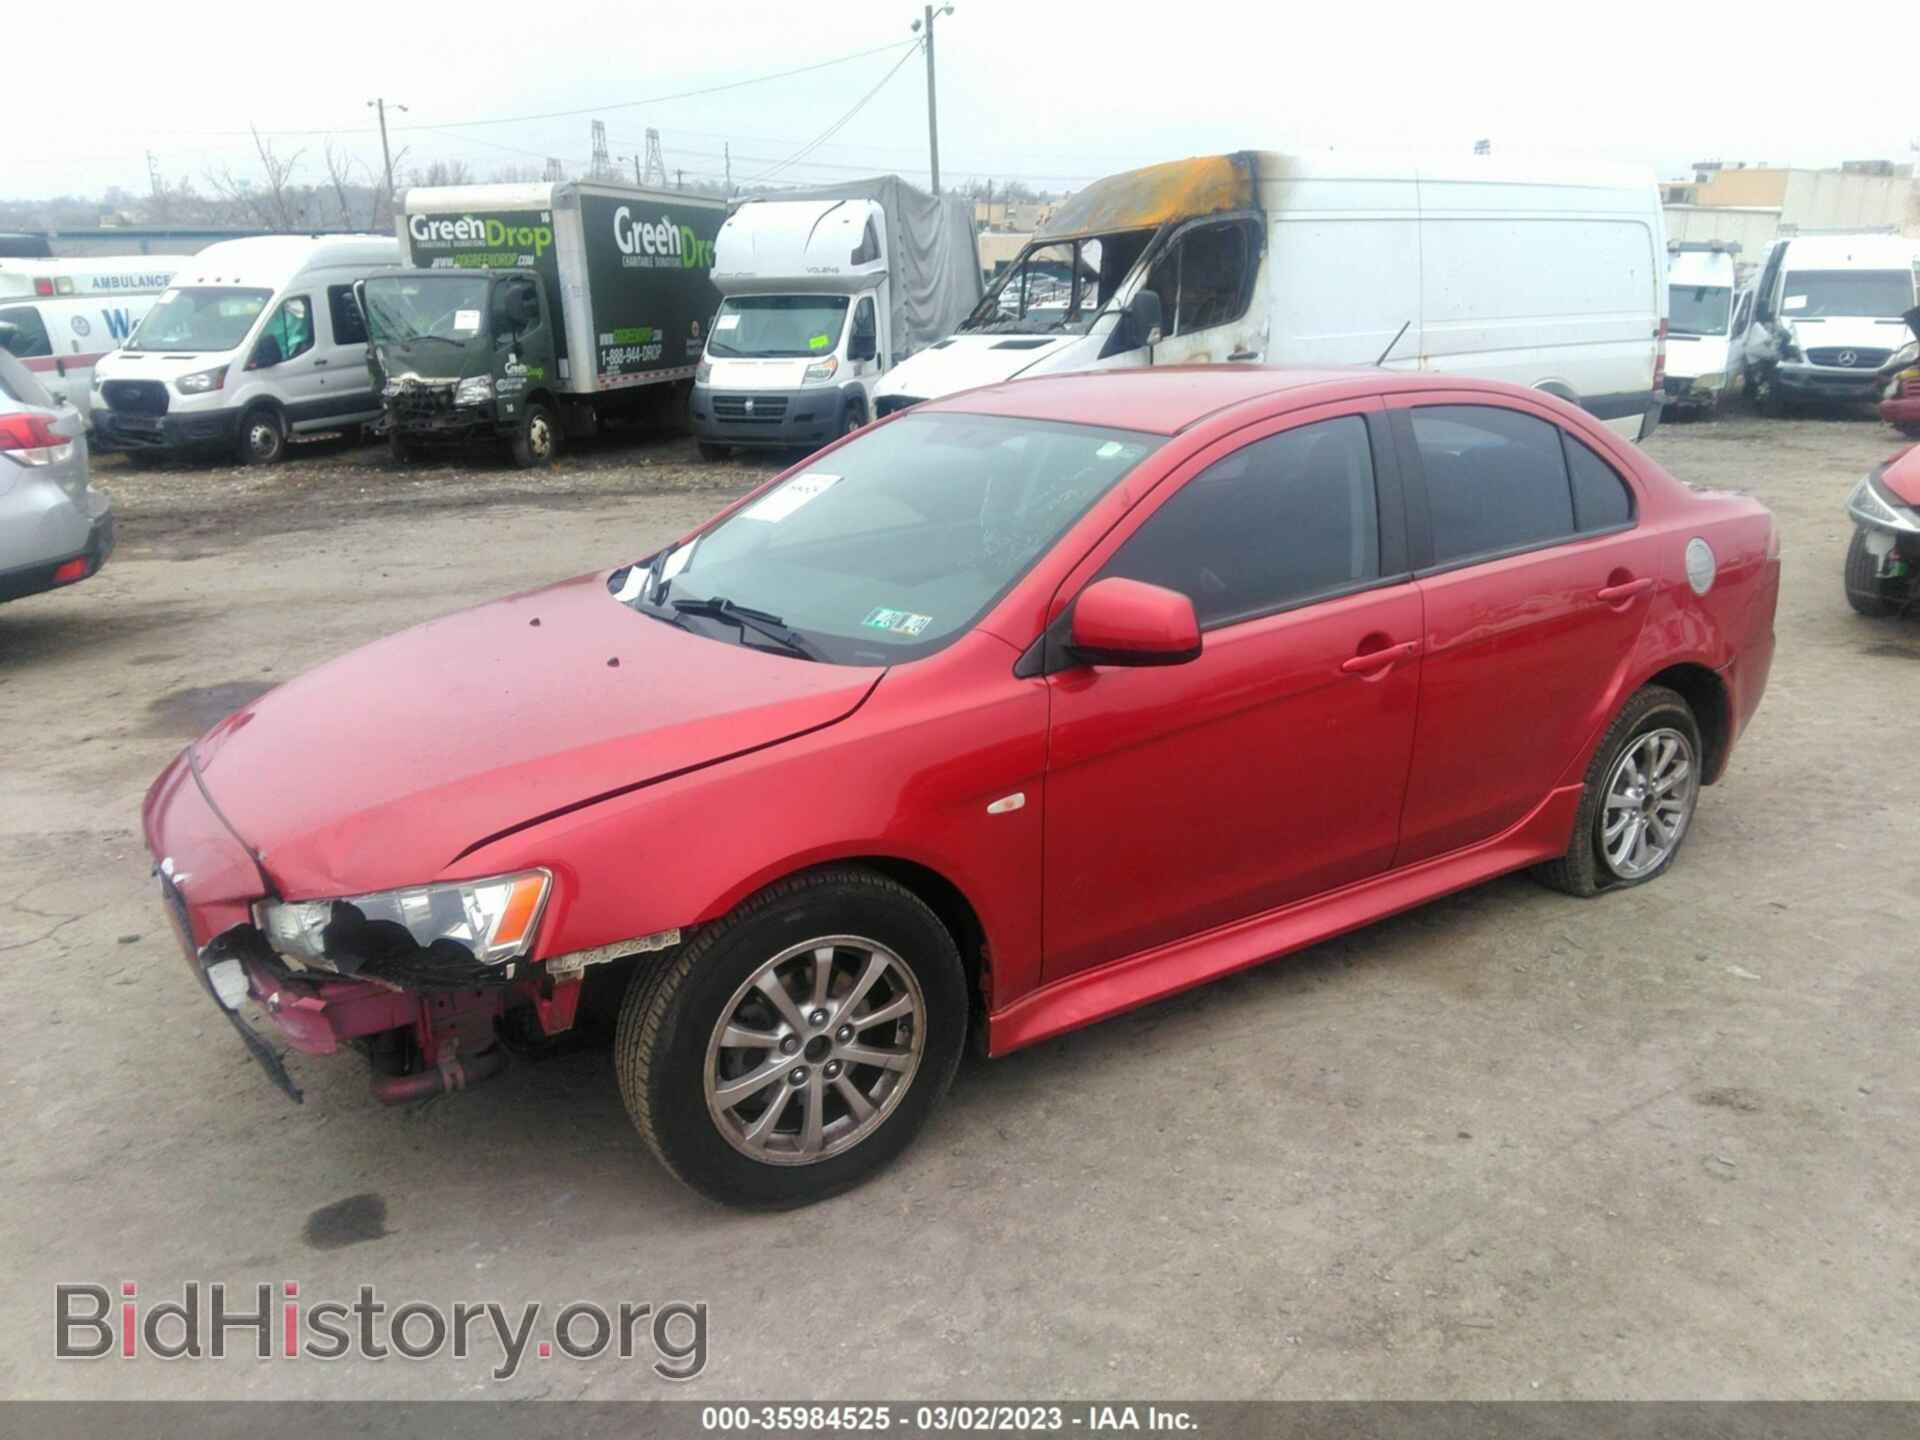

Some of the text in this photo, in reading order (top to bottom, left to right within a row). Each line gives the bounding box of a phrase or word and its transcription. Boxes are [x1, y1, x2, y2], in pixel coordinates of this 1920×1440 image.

[409, 214, 552, 256] GreenDrop
[614, 206, 713, 269] GreenDro
[92, 274, 170, 289] AMBULANCE
